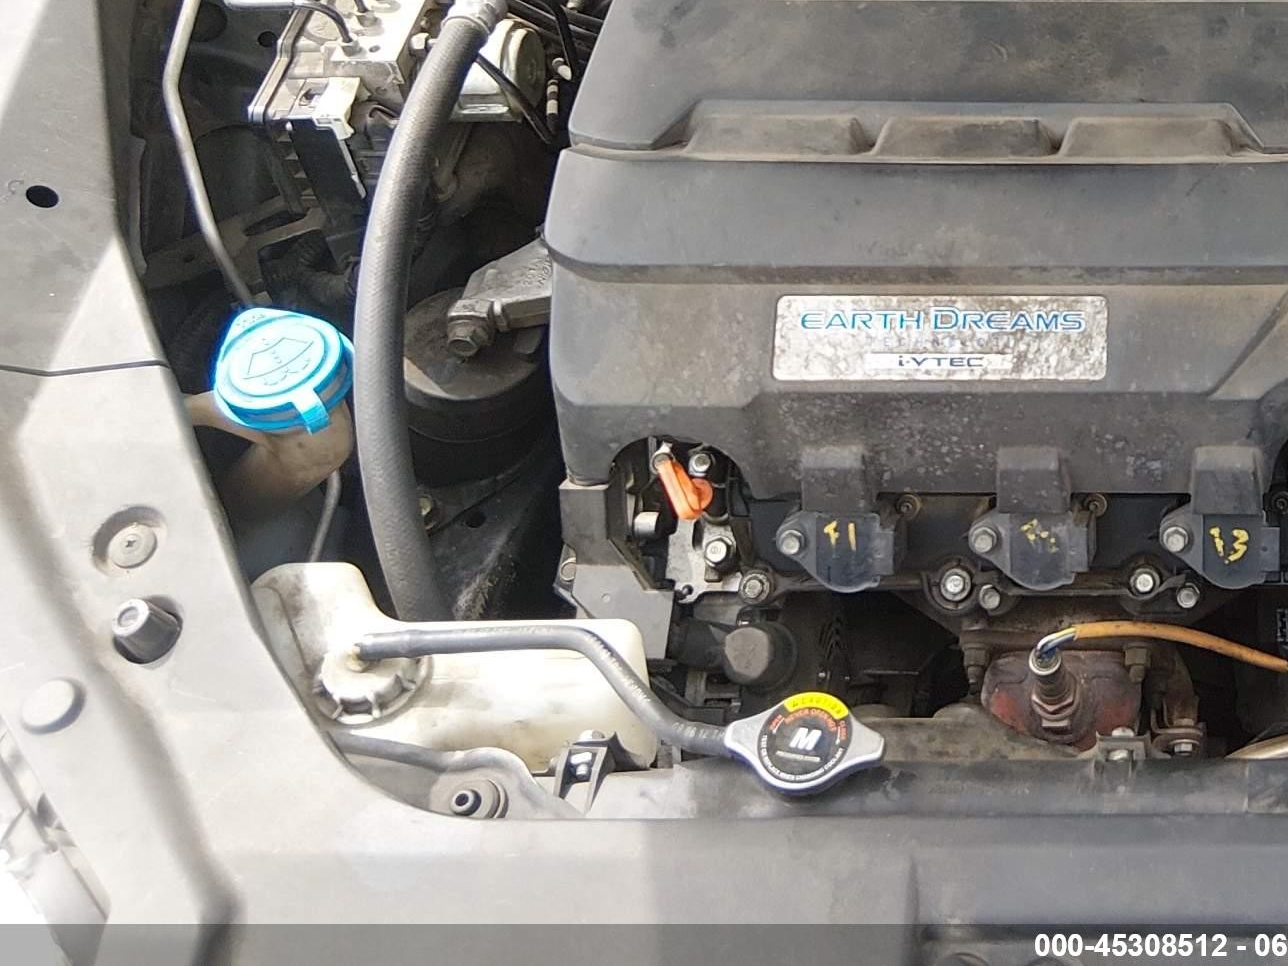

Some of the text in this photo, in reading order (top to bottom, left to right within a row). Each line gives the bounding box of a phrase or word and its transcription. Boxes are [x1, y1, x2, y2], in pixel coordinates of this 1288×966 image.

[800, 307, 1086, 332] EARTH DREAMS
[789, 727, 822, 751] M
